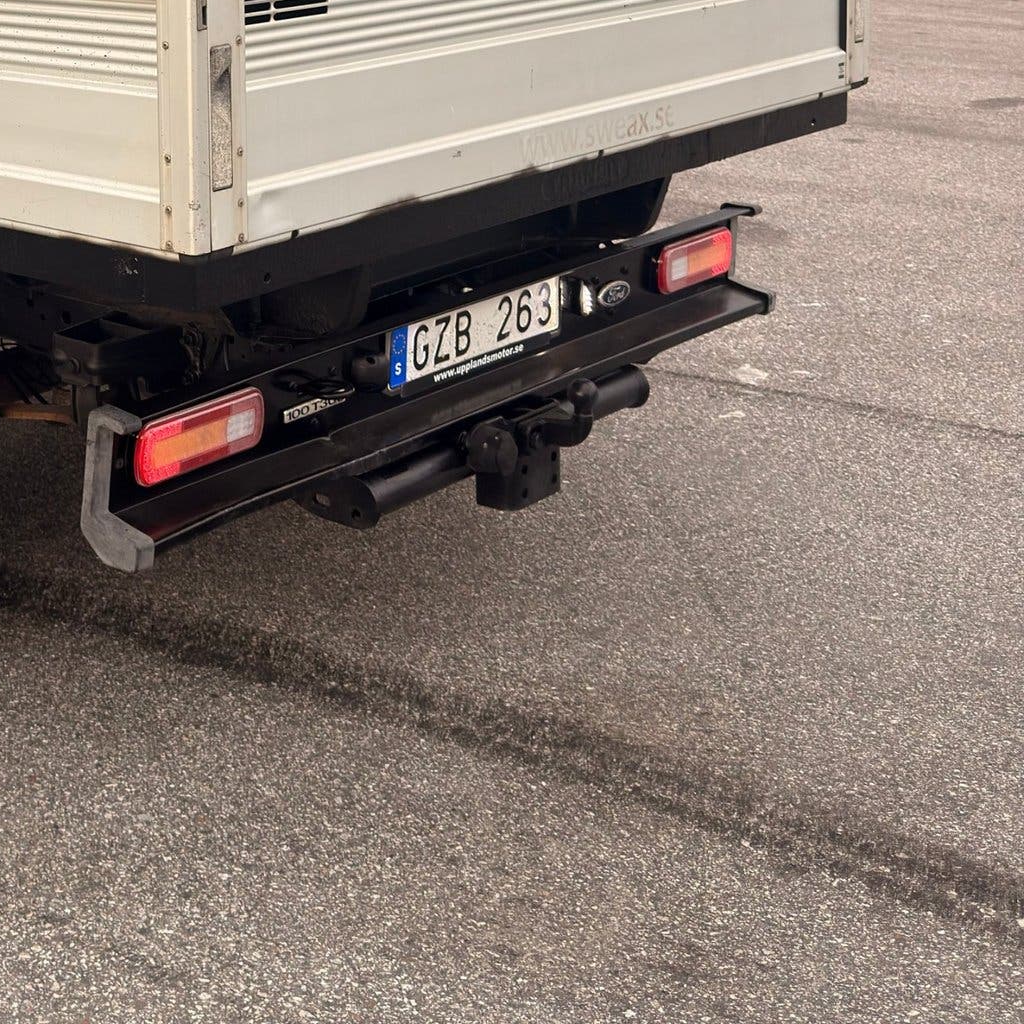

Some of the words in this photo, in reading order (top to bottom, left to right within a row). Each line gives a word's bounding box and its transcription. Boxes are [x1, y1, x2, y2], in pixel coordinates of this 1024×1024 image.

[413, 310, 472, 371] GZB
[497, 282, 552, 342] 263
[394, 362, 402, 376] S
[433, 343, 525, 383] www.upplandsmotor.se
[288, 405, 309, 421] 100
